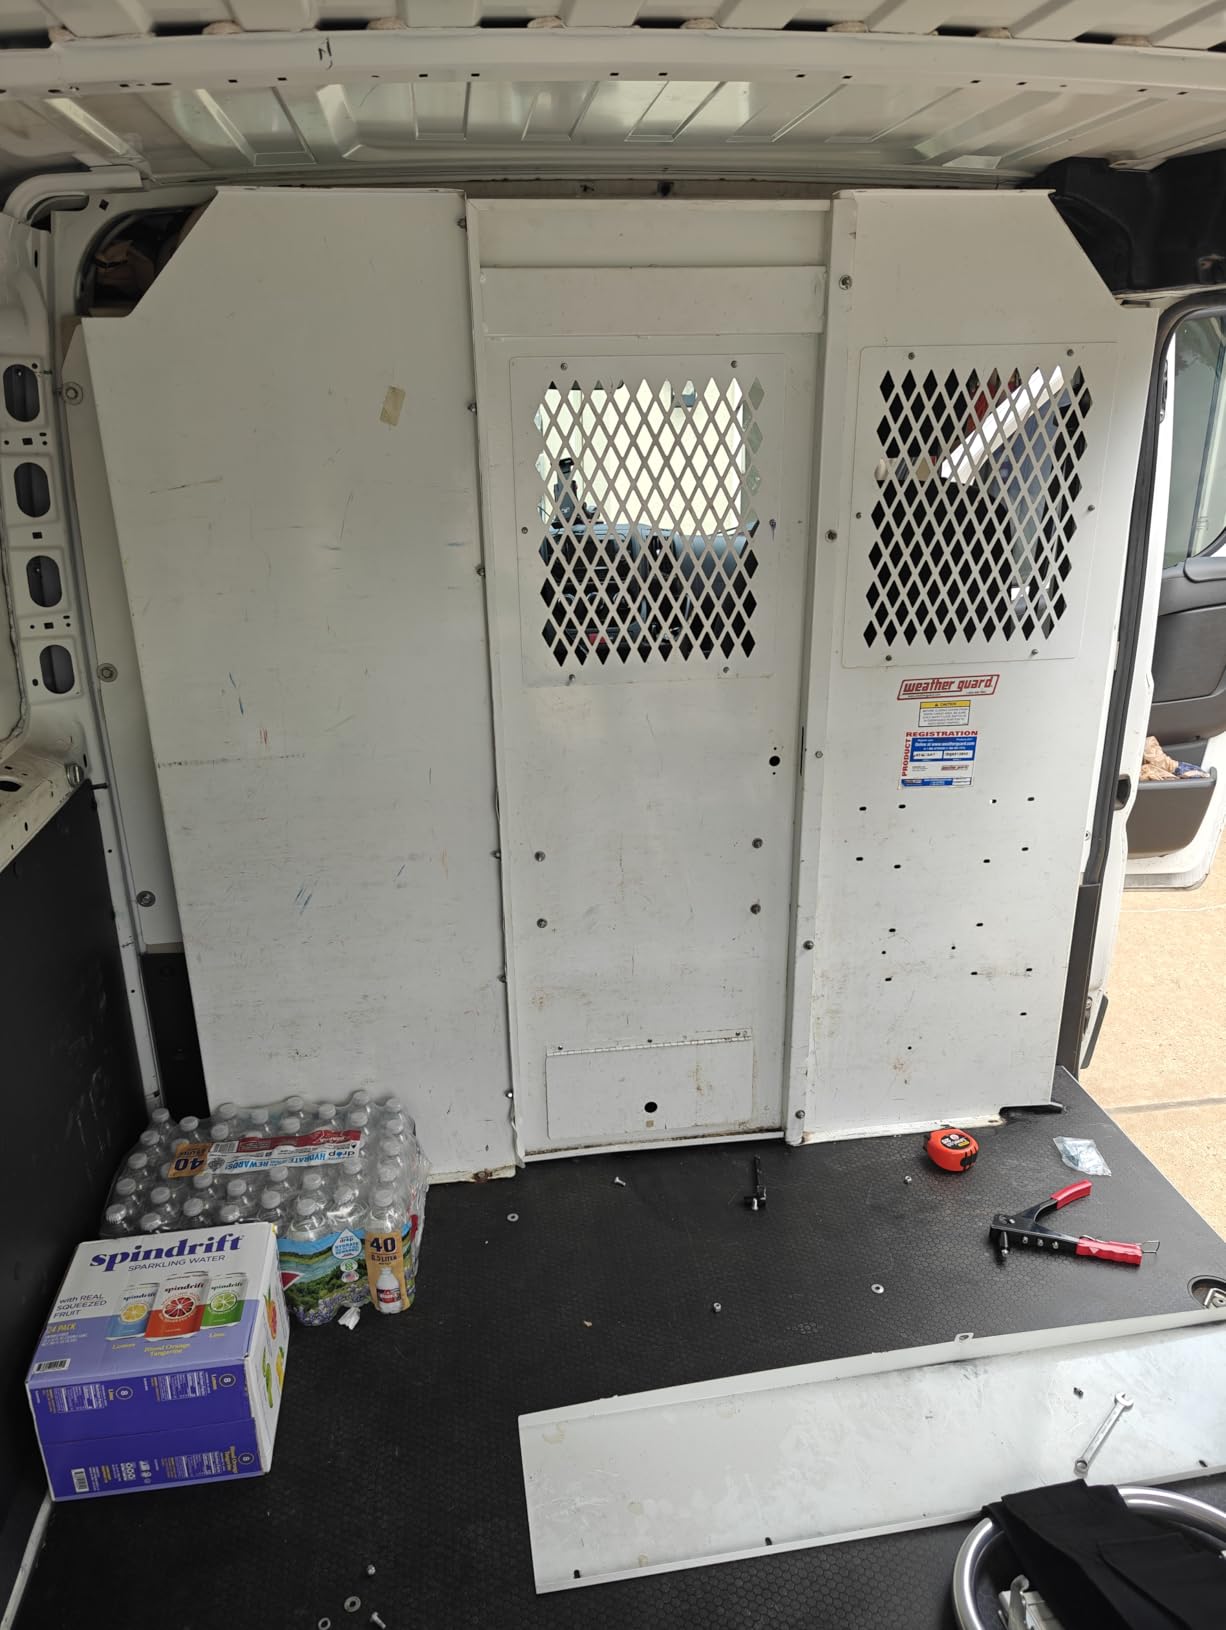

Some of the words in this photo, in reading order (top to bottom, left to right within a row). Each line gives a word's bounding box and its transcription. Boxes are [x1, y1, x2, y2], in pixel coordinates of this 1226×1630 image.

[903, 679, 955, 693] weather
[957, 676, 993, 692] guard
[905, 730, 978, 738] REGISTRATION
[901, 738, 911, 777] PRODUCT
[174, 1157, 205, 1171] 40
[89, 1232, 242, 1272] spindrift
[370, 1237, 396, 1253] 40
[128, 1258, 186, 1272] SPARKLING
[189, 1254, 226, 1265] WATER
[164, 1282, 206, 1293] spindrift
[59, 1295, 79, 1304] with
[80, 1293, 105, 1301] REAL
[56, 1300, 108, 1312] SQUEEZED
[53, 1309, 81, 1319] FRUIT
